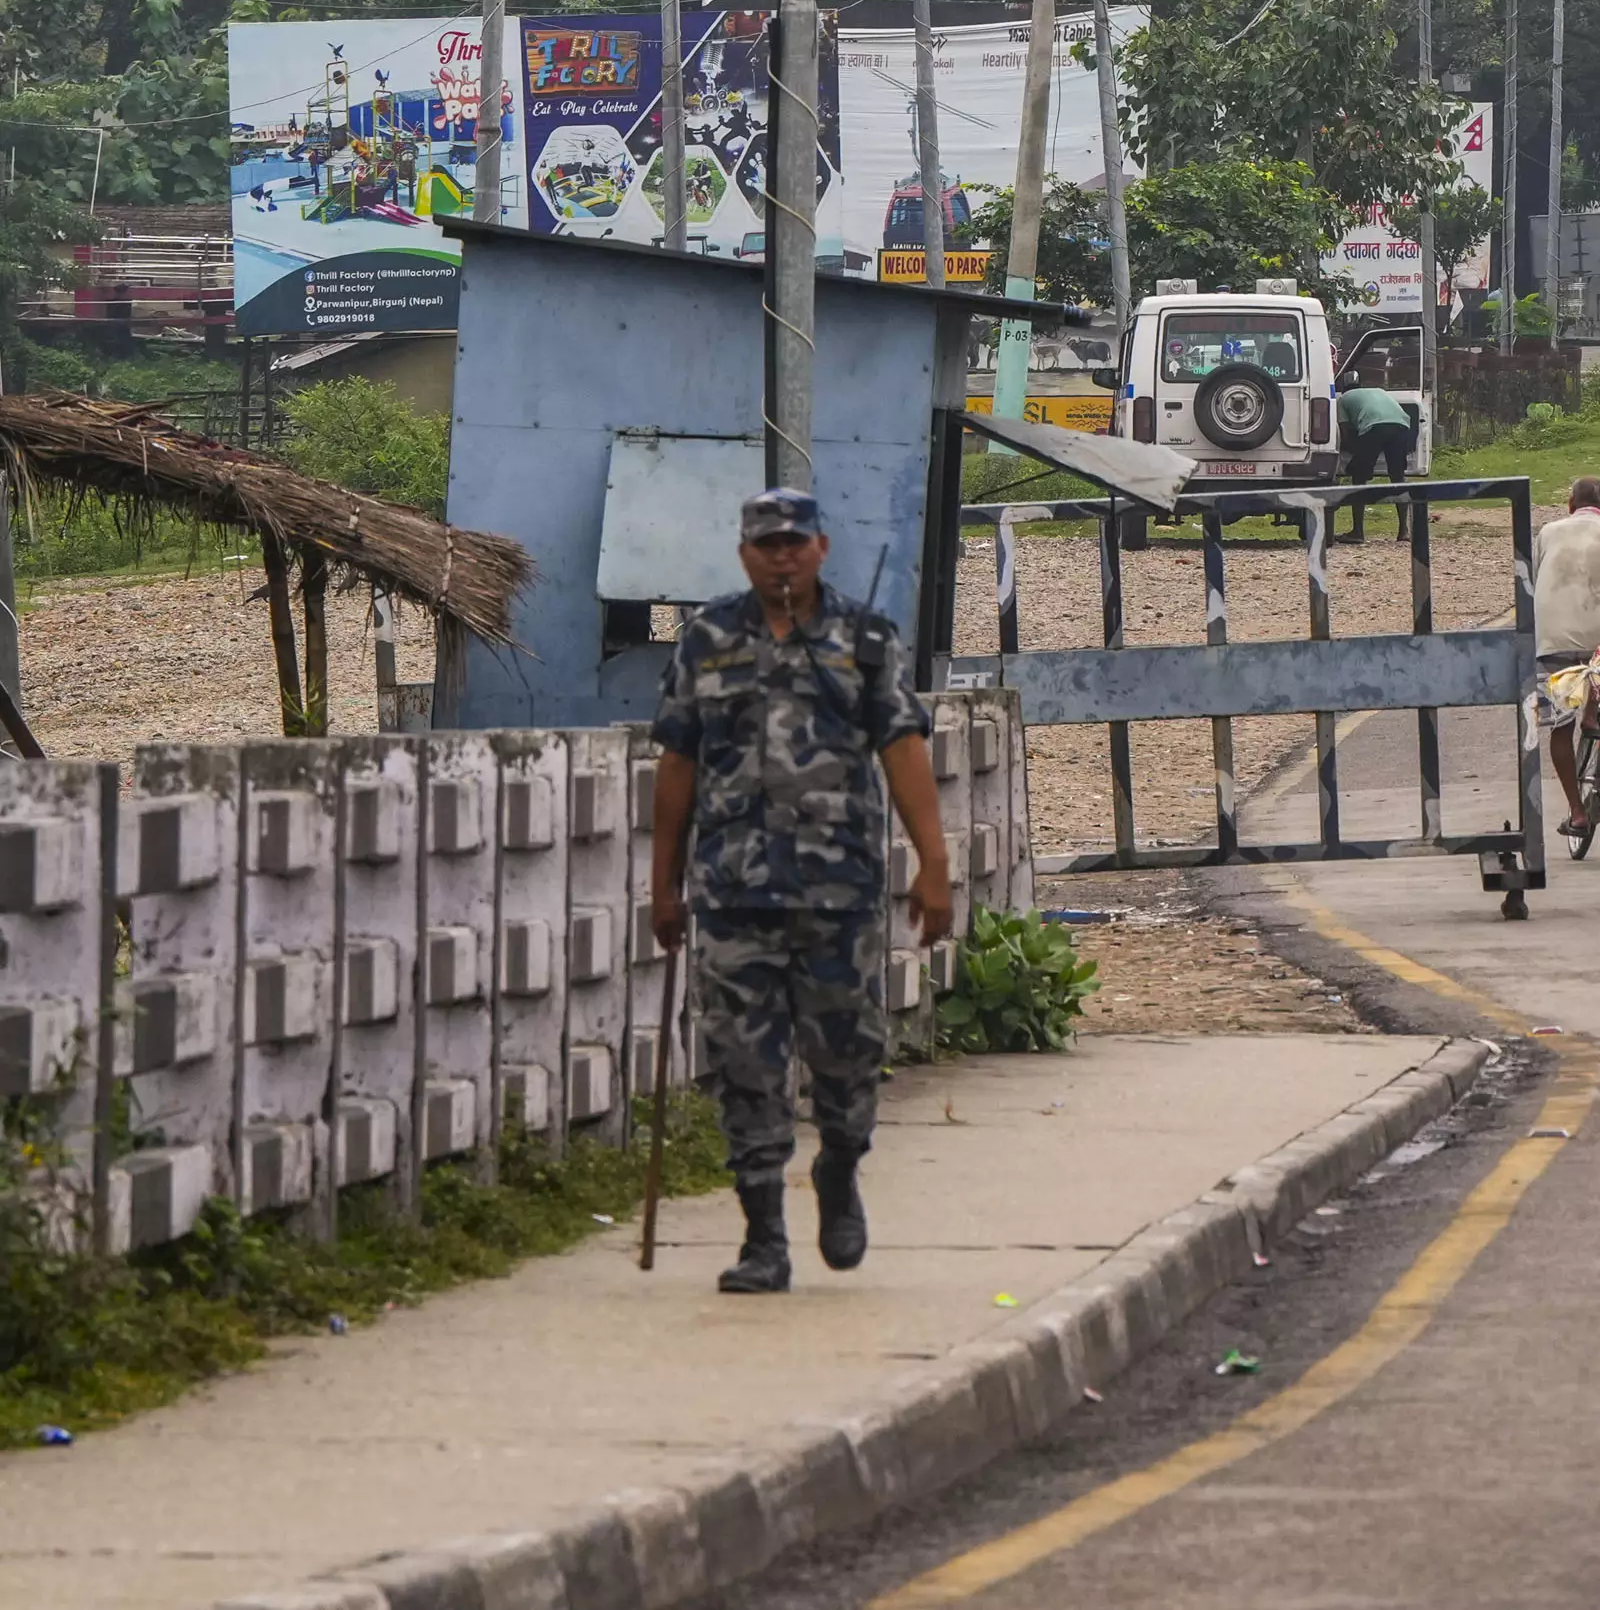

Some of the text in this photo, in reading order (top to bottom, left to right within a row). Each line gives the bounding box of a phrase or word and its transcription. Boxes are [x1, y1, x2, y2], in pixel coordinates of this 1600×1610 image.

[437, 31, 483, 64] Thri
[983, 53, 1021, 70] Heartily
[532, 100, 638, 117] Eat Play Celebrate
[884, 256, 926, 275] WELCO
[957, 256, 989, 275] PARS
[316, 270, 338, 280] Thrill
[340, 270, 375, 281] Factory
[316, 284, 375, 294] Thrill Factory
[409, 295, 444, 307] (Nepal)
[316, 314, 375, 324] 9802919018
